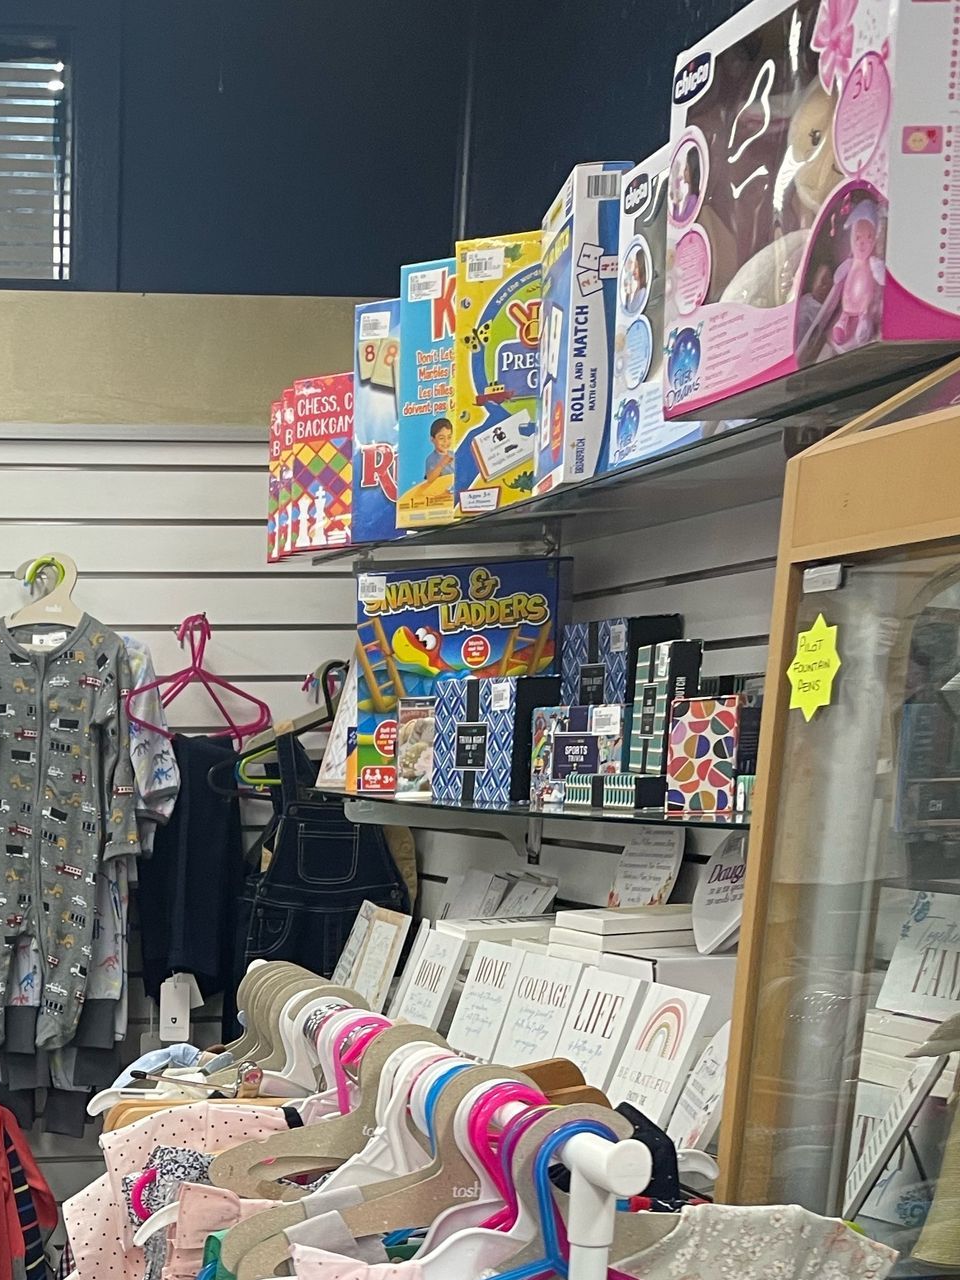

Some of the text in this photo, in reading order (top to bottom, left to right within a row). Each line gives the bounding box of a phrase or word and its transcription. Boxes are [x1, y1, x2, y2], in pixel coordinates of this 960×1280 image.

[570, 305, 589, 422] ROLL AND MATCH
[588, 367, 598, 411] MATH GAME
[297, 395, 340, 417] CHESS,
[470, 569, 499, 599] &
[440, 594, 548, 632] LADDERS
[793, 660, 831, 673] FOUNTAIN
[798, 679, 821, 692] PENS
[565, 746, 588, 755] SPORTS
[383, 774, 394, 783] 3+
[414, 959, 446, 994] HOME
[474, 956, 512, 990] HOME
[517, 975, 572, 1009] COURAGE
[573, 988, 624, 1040] LIFE
[630, 1068, 672, 1095] GRATEFUL
